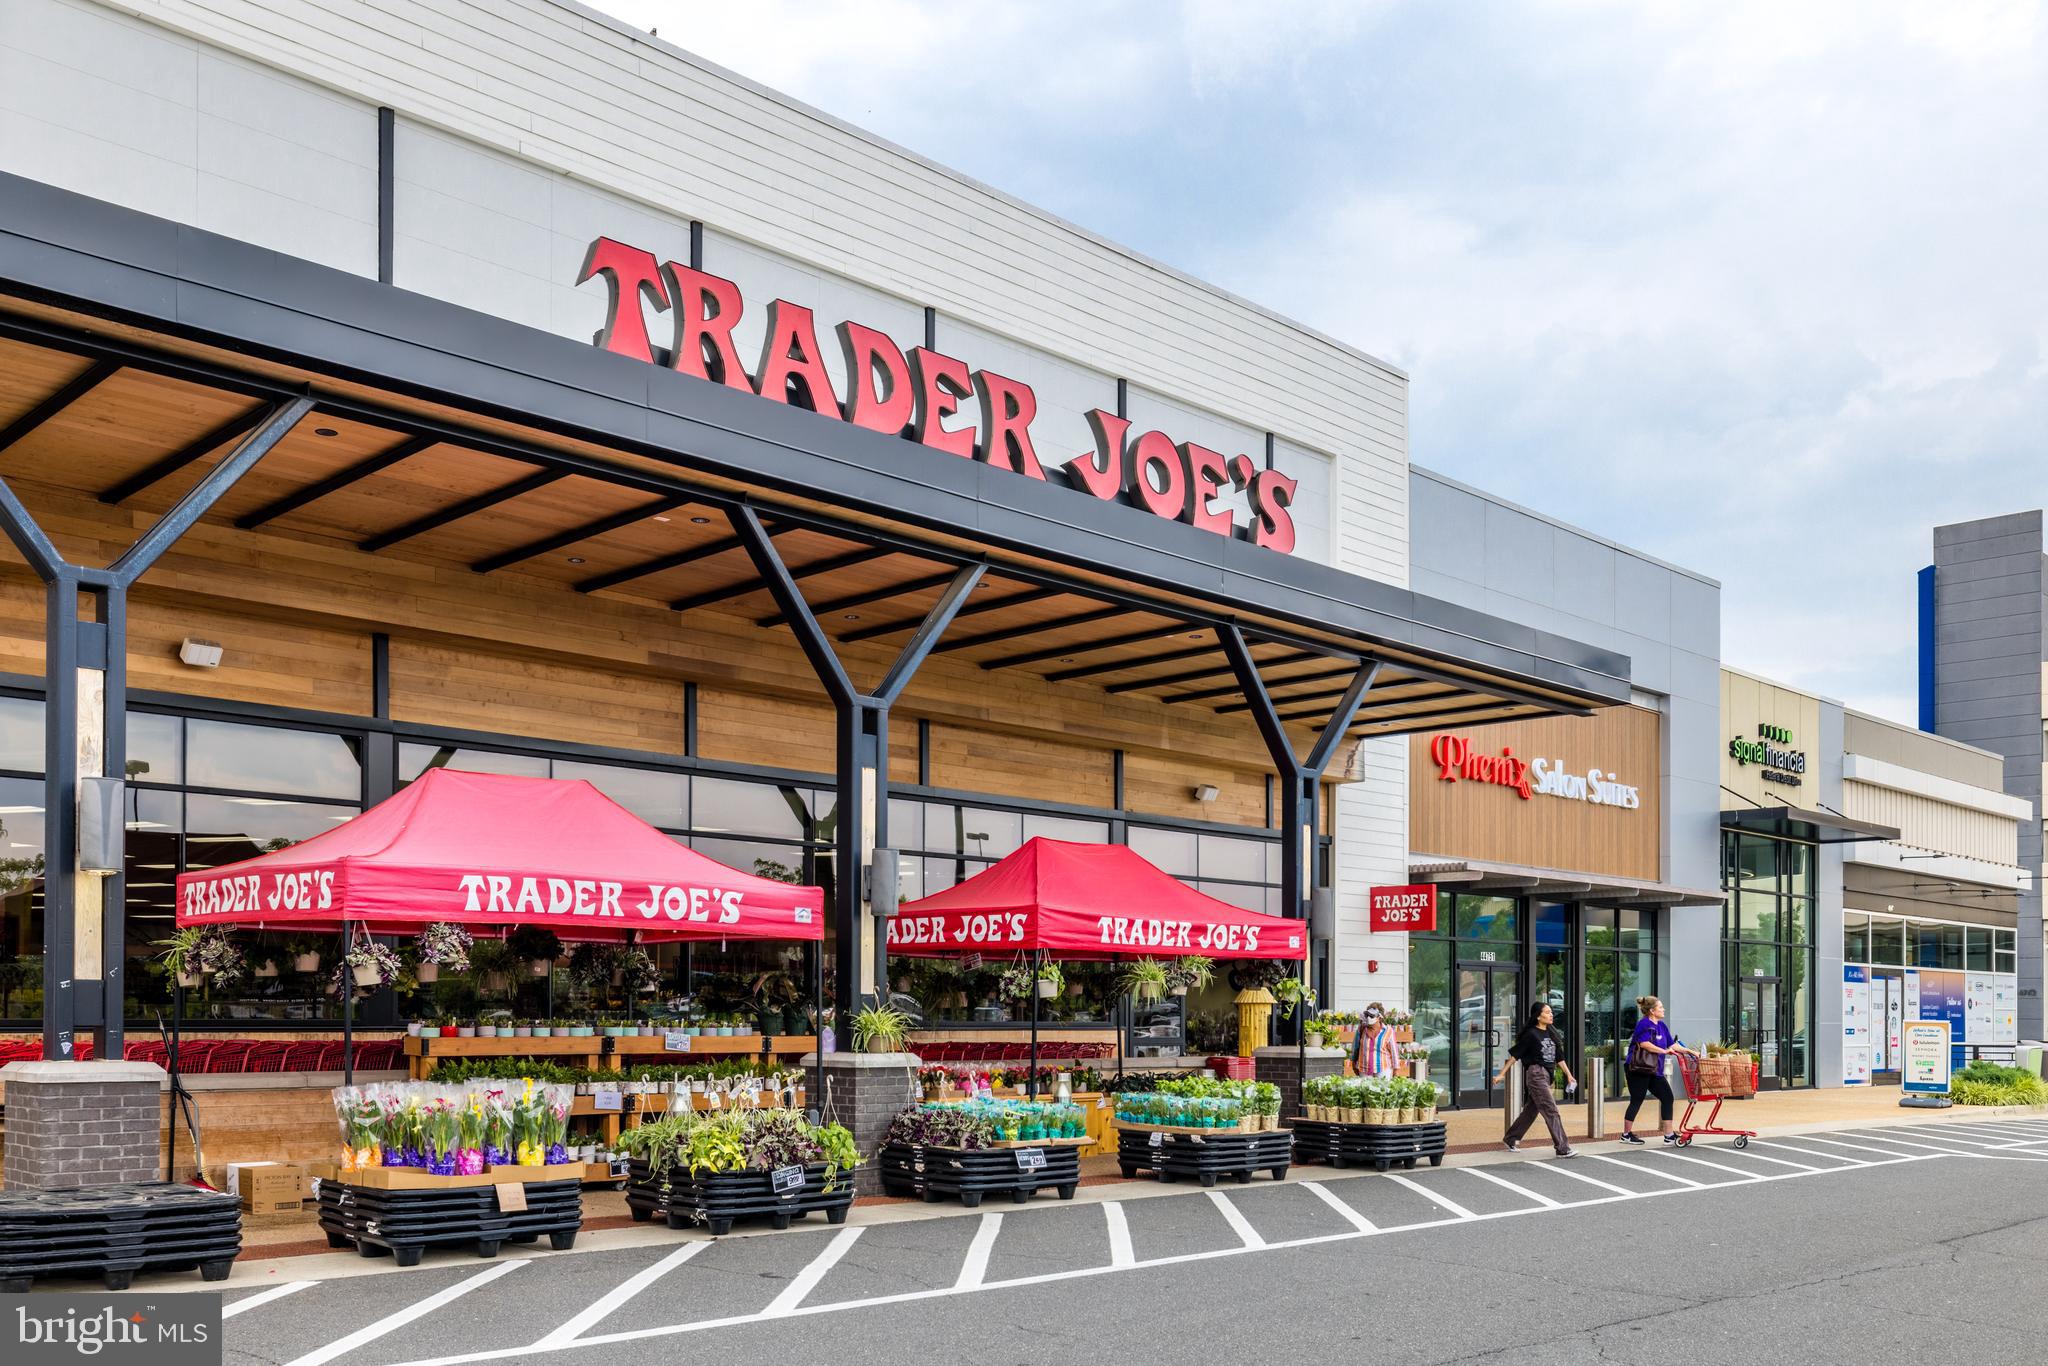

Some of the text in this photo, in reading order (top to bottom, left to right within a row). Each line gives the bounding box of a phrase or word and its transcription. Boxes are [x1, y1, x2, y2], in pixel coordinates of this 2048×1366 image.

[575, 236, 1298, 554] TRADER JOE'S
[1431, 734, 1532, 800] Phenix
[184, 870, 335, 916] TRADER JOE'S
[458, 875, 744, 924] TRADER JOE'S
[1374, 893, 1429, 923] TRADER JOE'S
[886, 912, 1028, 945] ADER JOE'S
[1097, 916, 1261, 951] TRADER JOE'S
